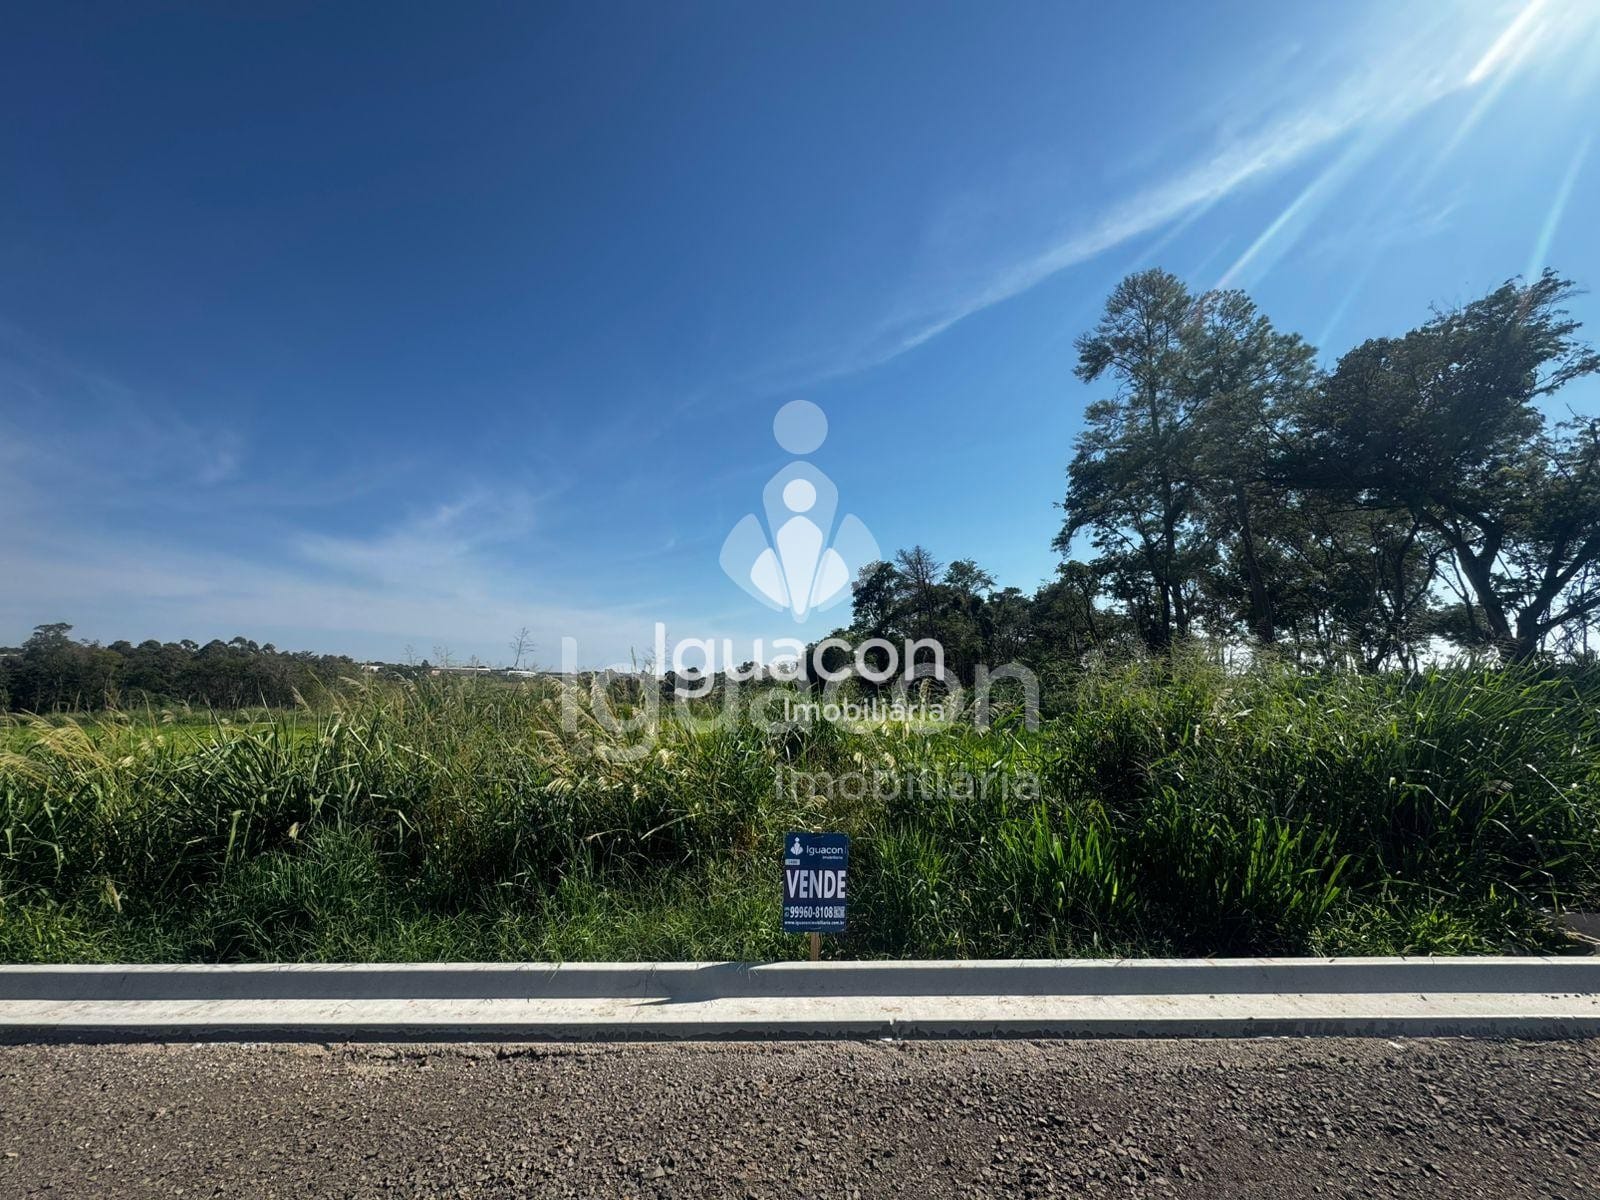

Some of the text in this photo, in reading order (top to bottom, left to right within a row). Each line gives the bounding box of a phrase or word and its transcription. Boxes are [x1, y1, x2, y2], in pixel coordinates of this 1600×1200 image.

[806, 845, 843, 856] Iguacon
[786, 870, 846, 898] VENDE
[790, 906, 833, 918] 99960-8108
